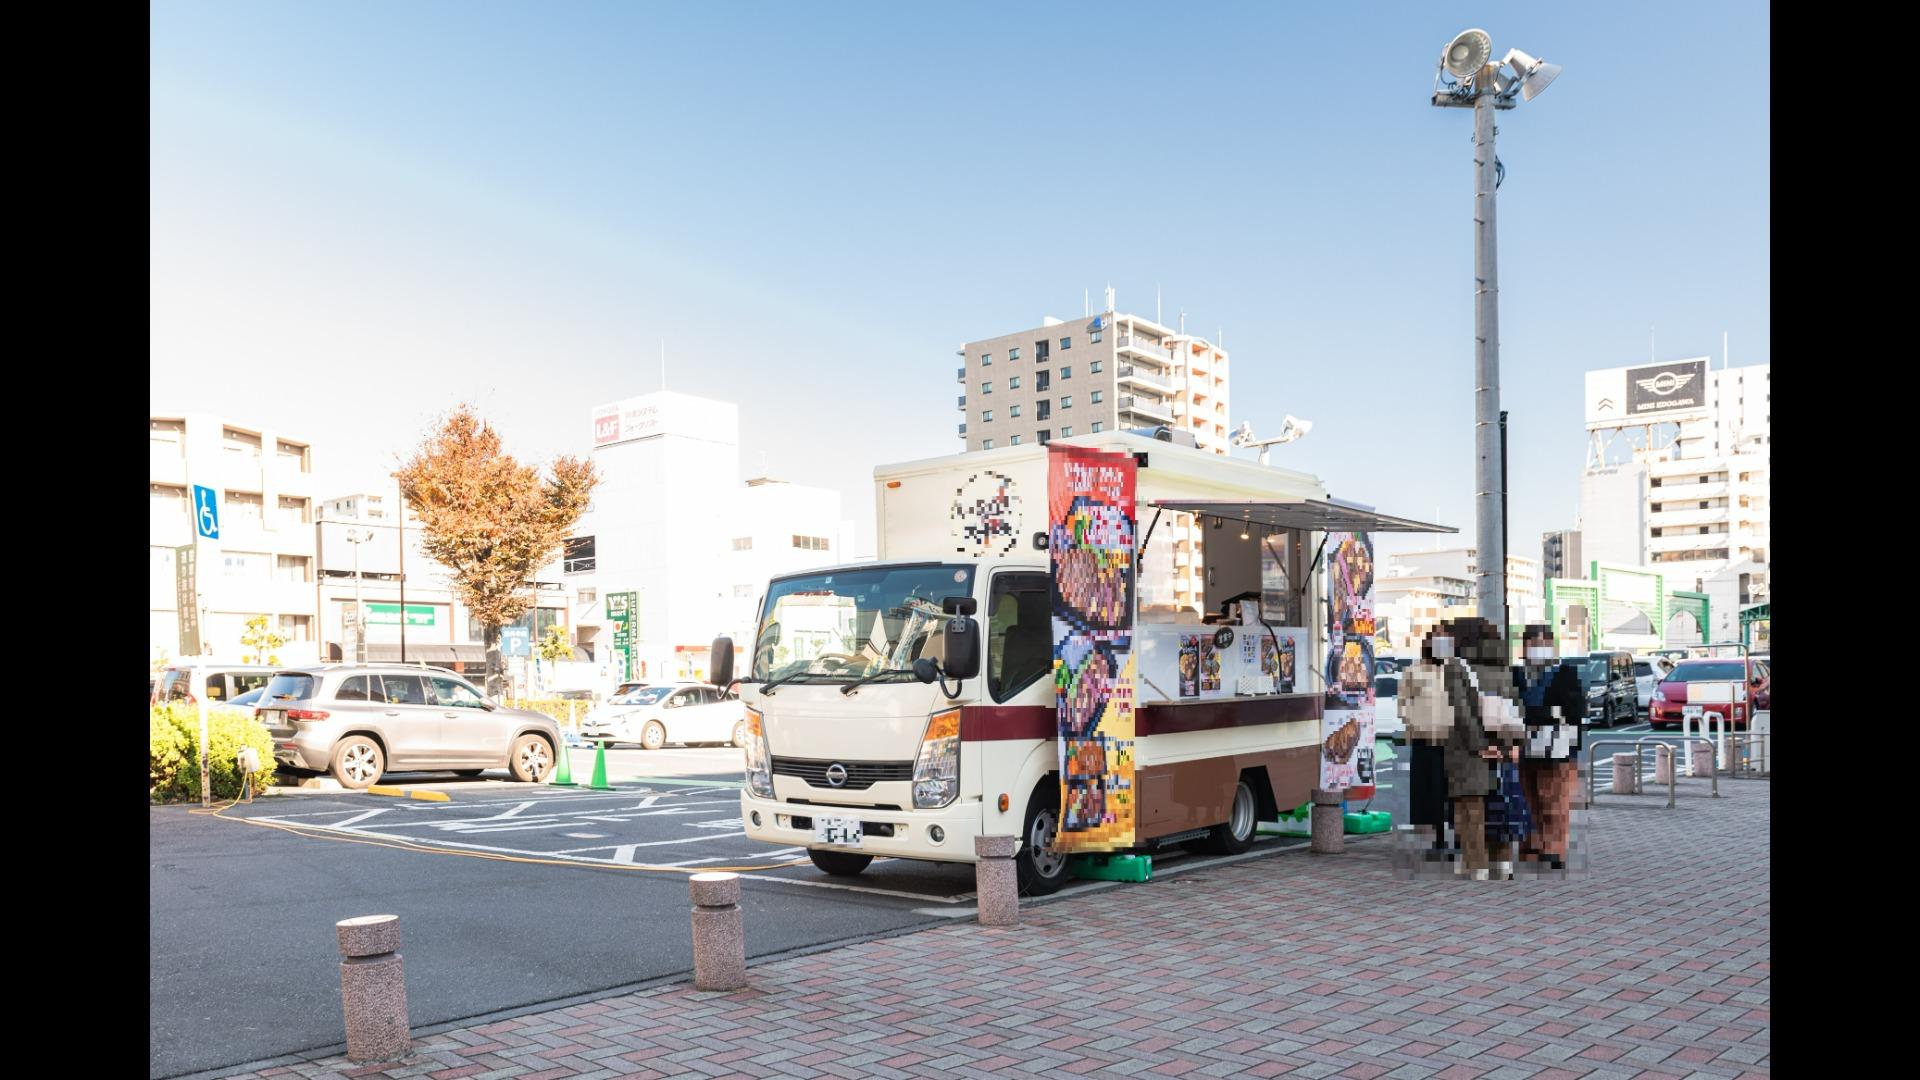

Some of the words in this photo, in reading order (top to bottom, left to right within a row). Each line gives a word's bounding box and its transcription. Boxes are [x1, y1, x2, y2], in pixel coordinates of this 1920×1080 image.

[1656, 379, 1675, 388] MINI
[1637, 402, 1655, 410] MINI
[1656, 398, 1694, 409] EDOGAWA
[596, 420, 618, 437] L&F
[510, 638, 522, 653] P
